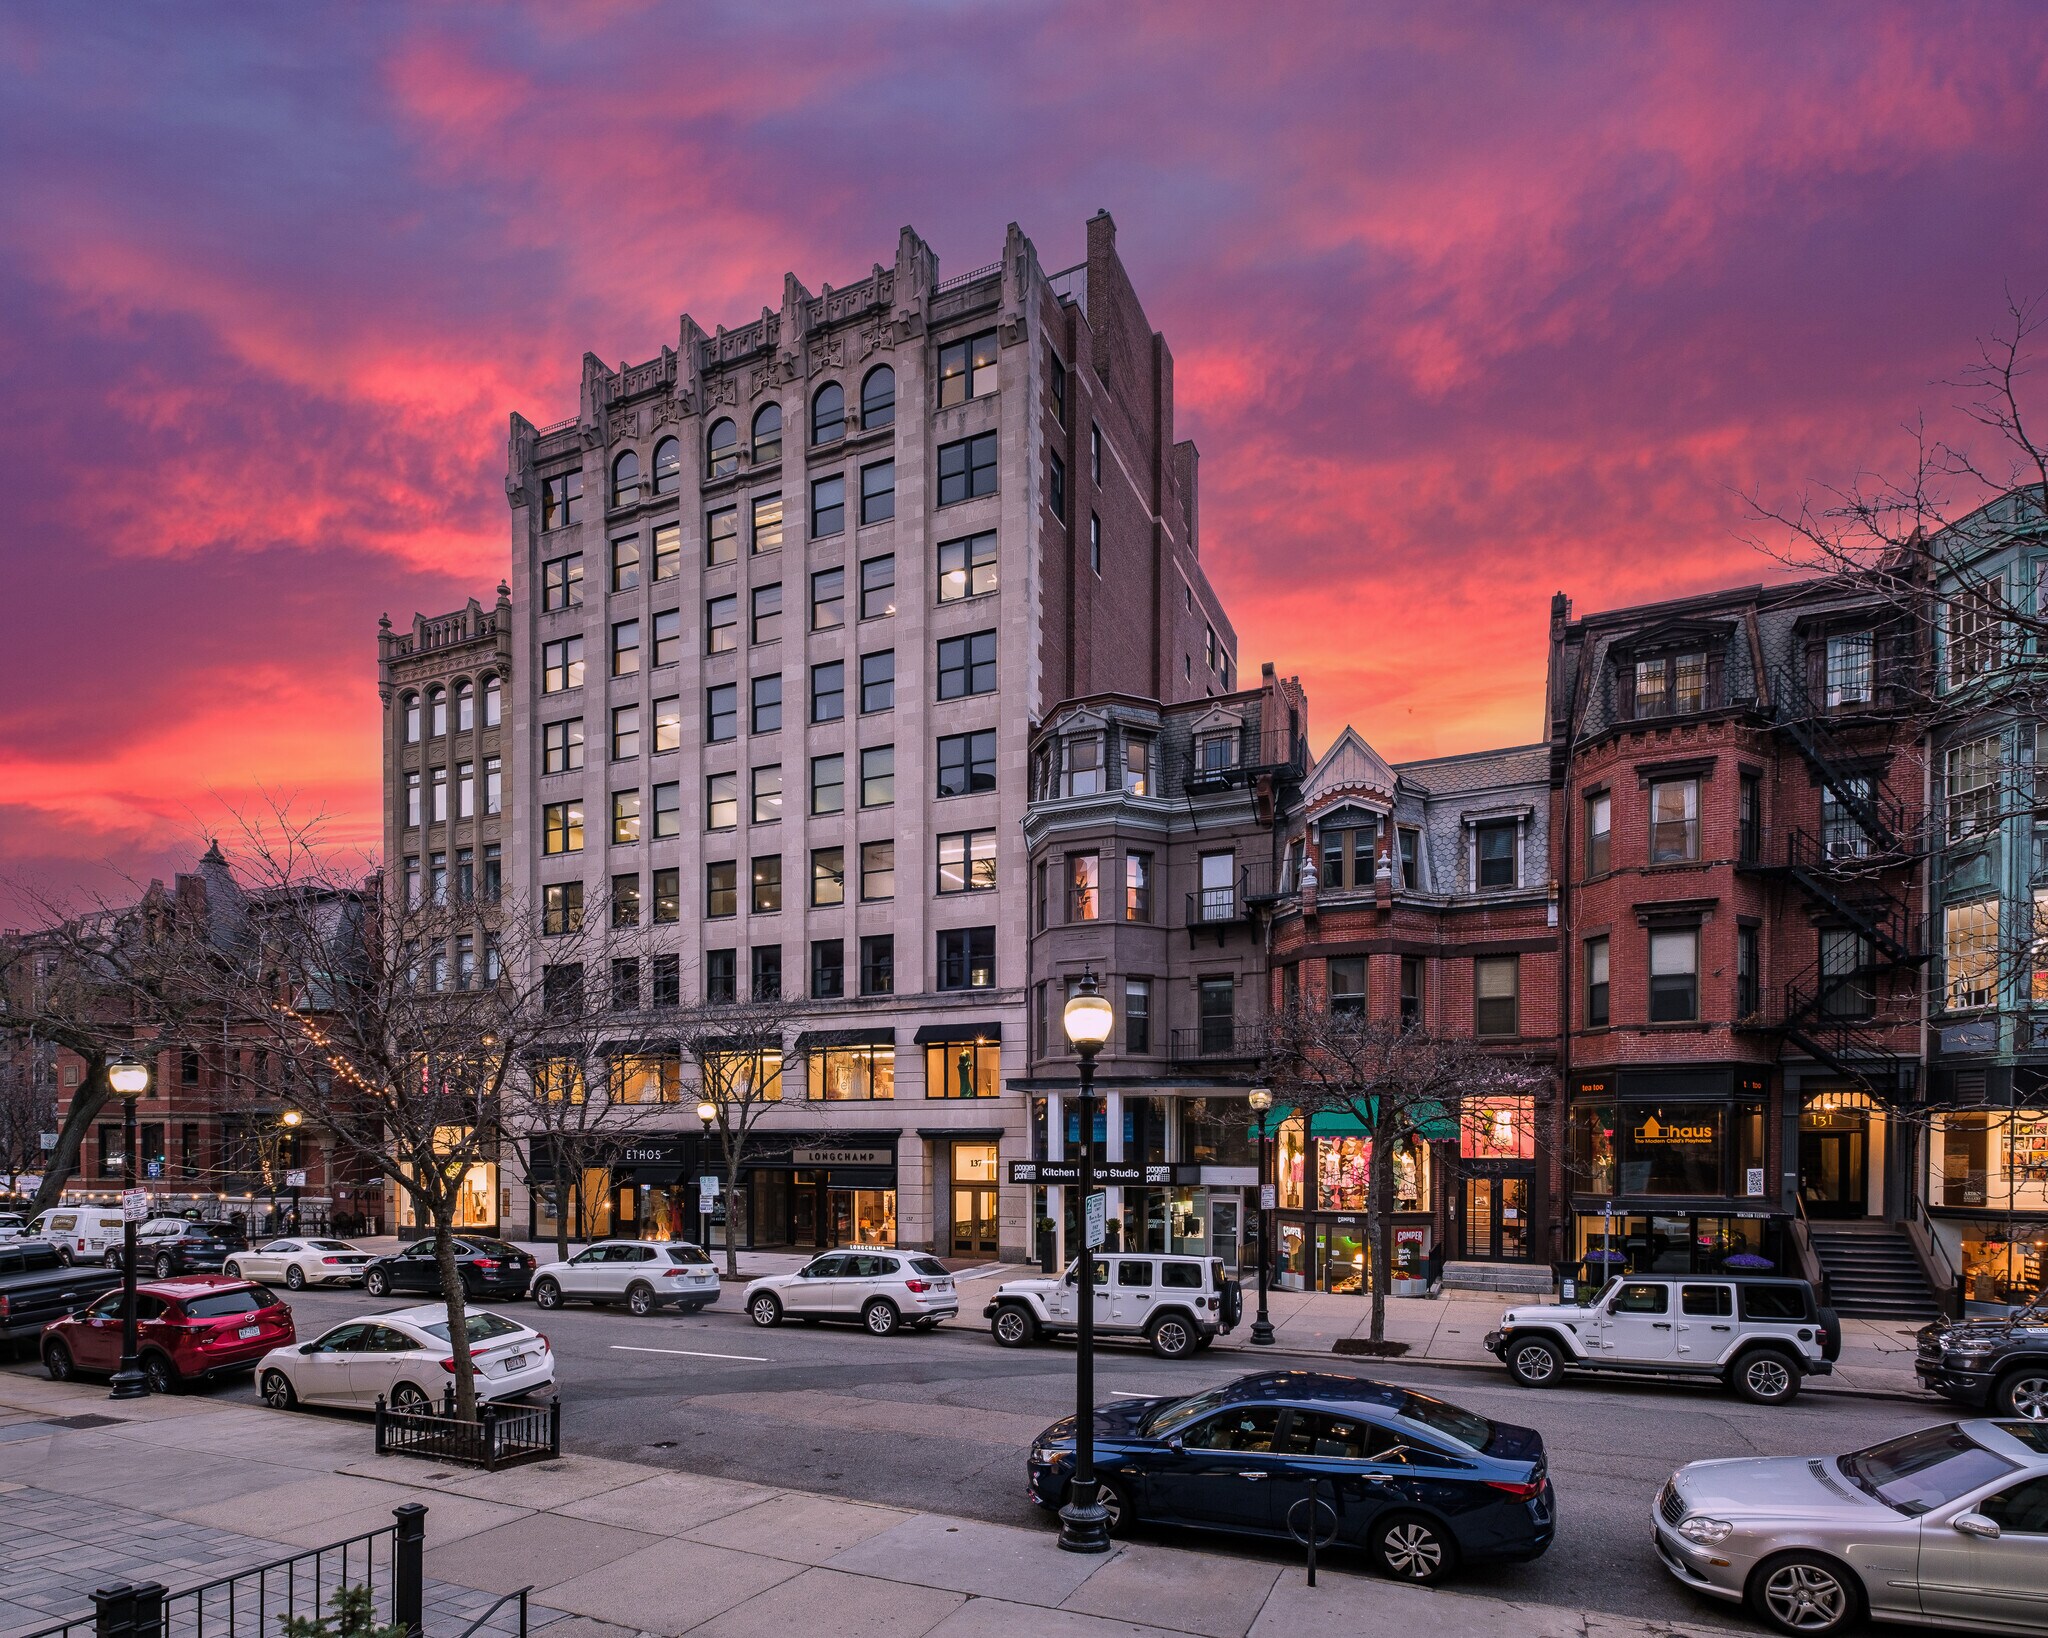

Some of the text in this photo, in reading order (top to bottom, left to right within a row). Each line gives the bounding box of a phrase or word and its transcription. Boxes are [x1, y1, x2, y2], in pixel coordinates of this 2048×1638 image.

[1812, 1114, 1833, 1127] 131
[1669, 1125, 1712, 1138] haus
[626, 1150, 661, 1160] ETHOS
[809, 1152, 875, 1161] LONGCHAMP
[970, 1160, 981, 1168] 137
[1014, 1164, 1036, 1173] poggen
[1042, 1168, 1074, 1177] Kitchen
[1110, 1169, 1140, 1178] Studio
[1146, 1166, 1170, 1175] poggen
[1338, 1216, 1356, 1224] CAMPER
[1282, 1225, 1302, 1240] CAMPER
[1397, 1230, 1423, 1242] CAMPER
